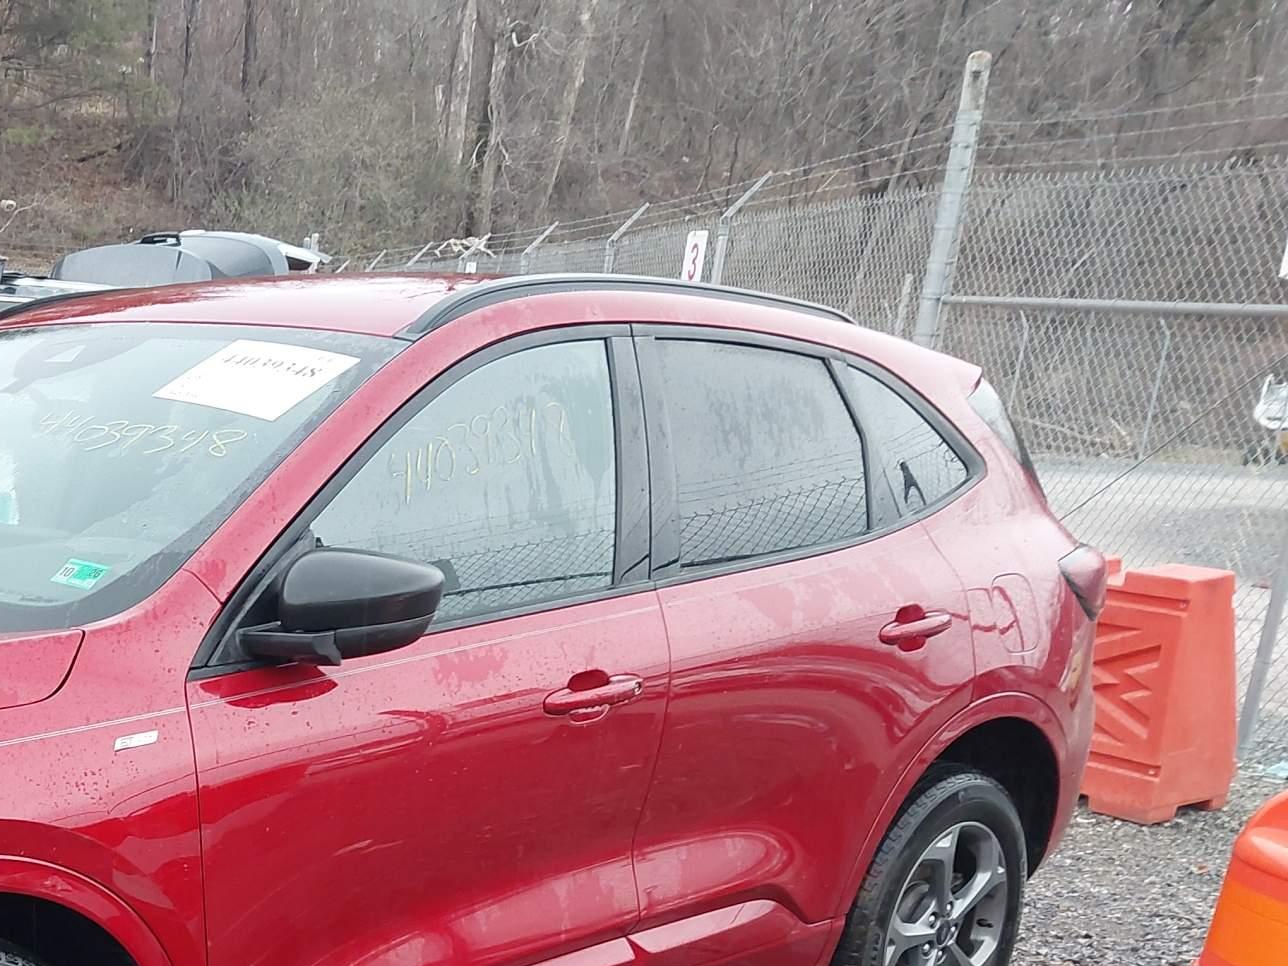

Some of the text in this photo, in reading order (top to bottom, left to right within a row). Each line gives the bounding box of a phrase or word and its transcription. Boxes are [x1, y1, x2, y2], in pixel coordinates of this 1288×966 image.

[688, 243, 699, 281] 3
[40, 410, 248, 457] 44039348
[59, 566, 75, 578] 10
